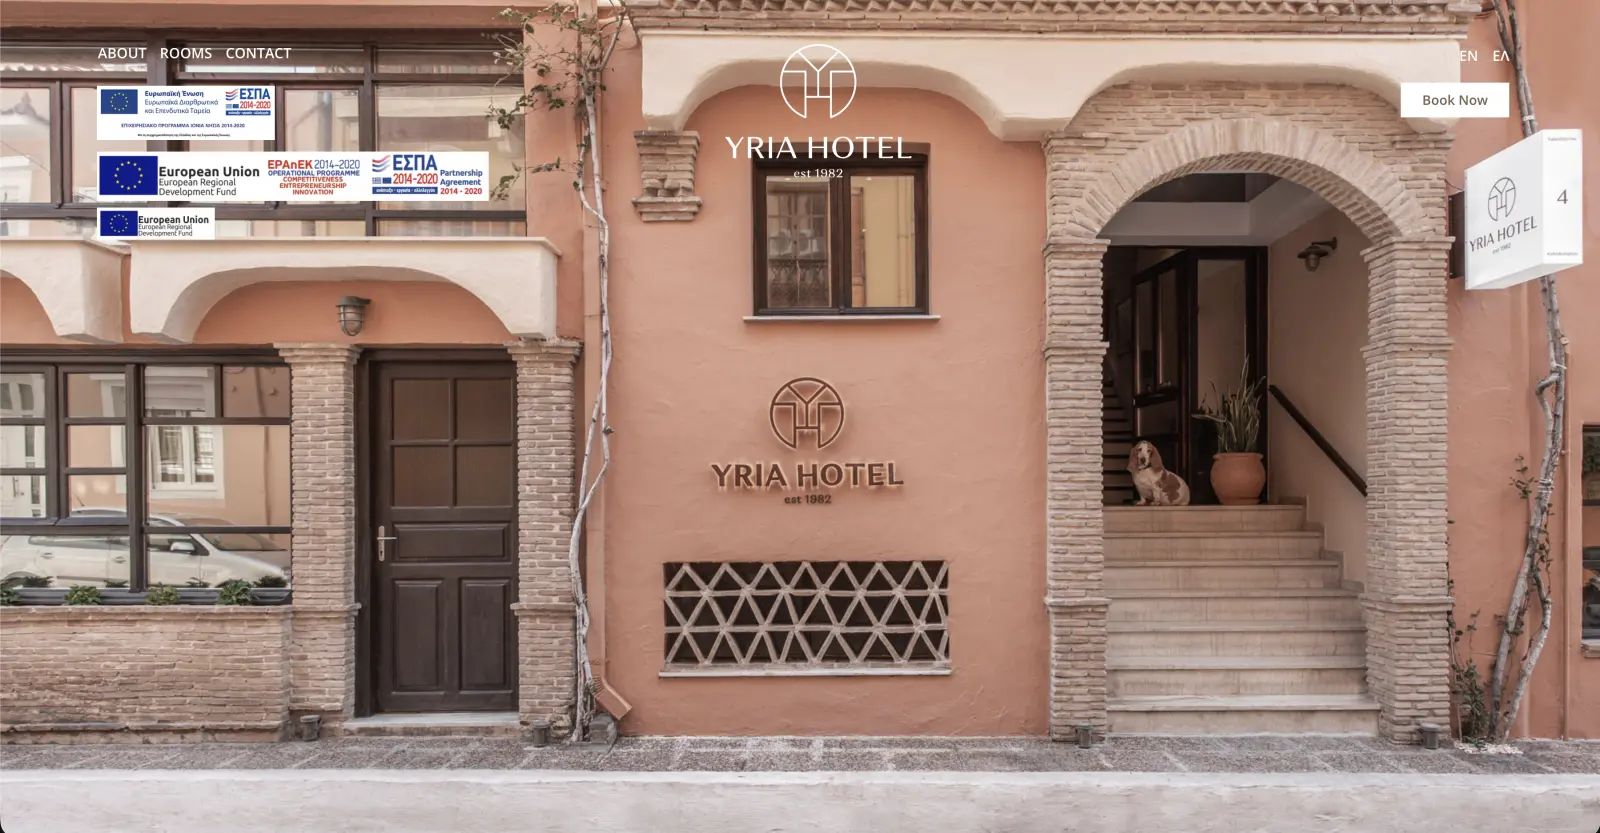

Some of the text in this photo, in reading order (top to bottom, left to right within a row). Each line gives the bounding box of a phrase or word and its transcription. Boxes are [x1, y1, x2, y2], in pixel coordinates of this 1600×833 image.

[1557, 189, 1568, 204] 4
[1469, 215, 1538, 253] YRIA HOTEL
[711, 462, 904, 487] YRIA HOTEL
[784, 494, 832, 504] est 1982
